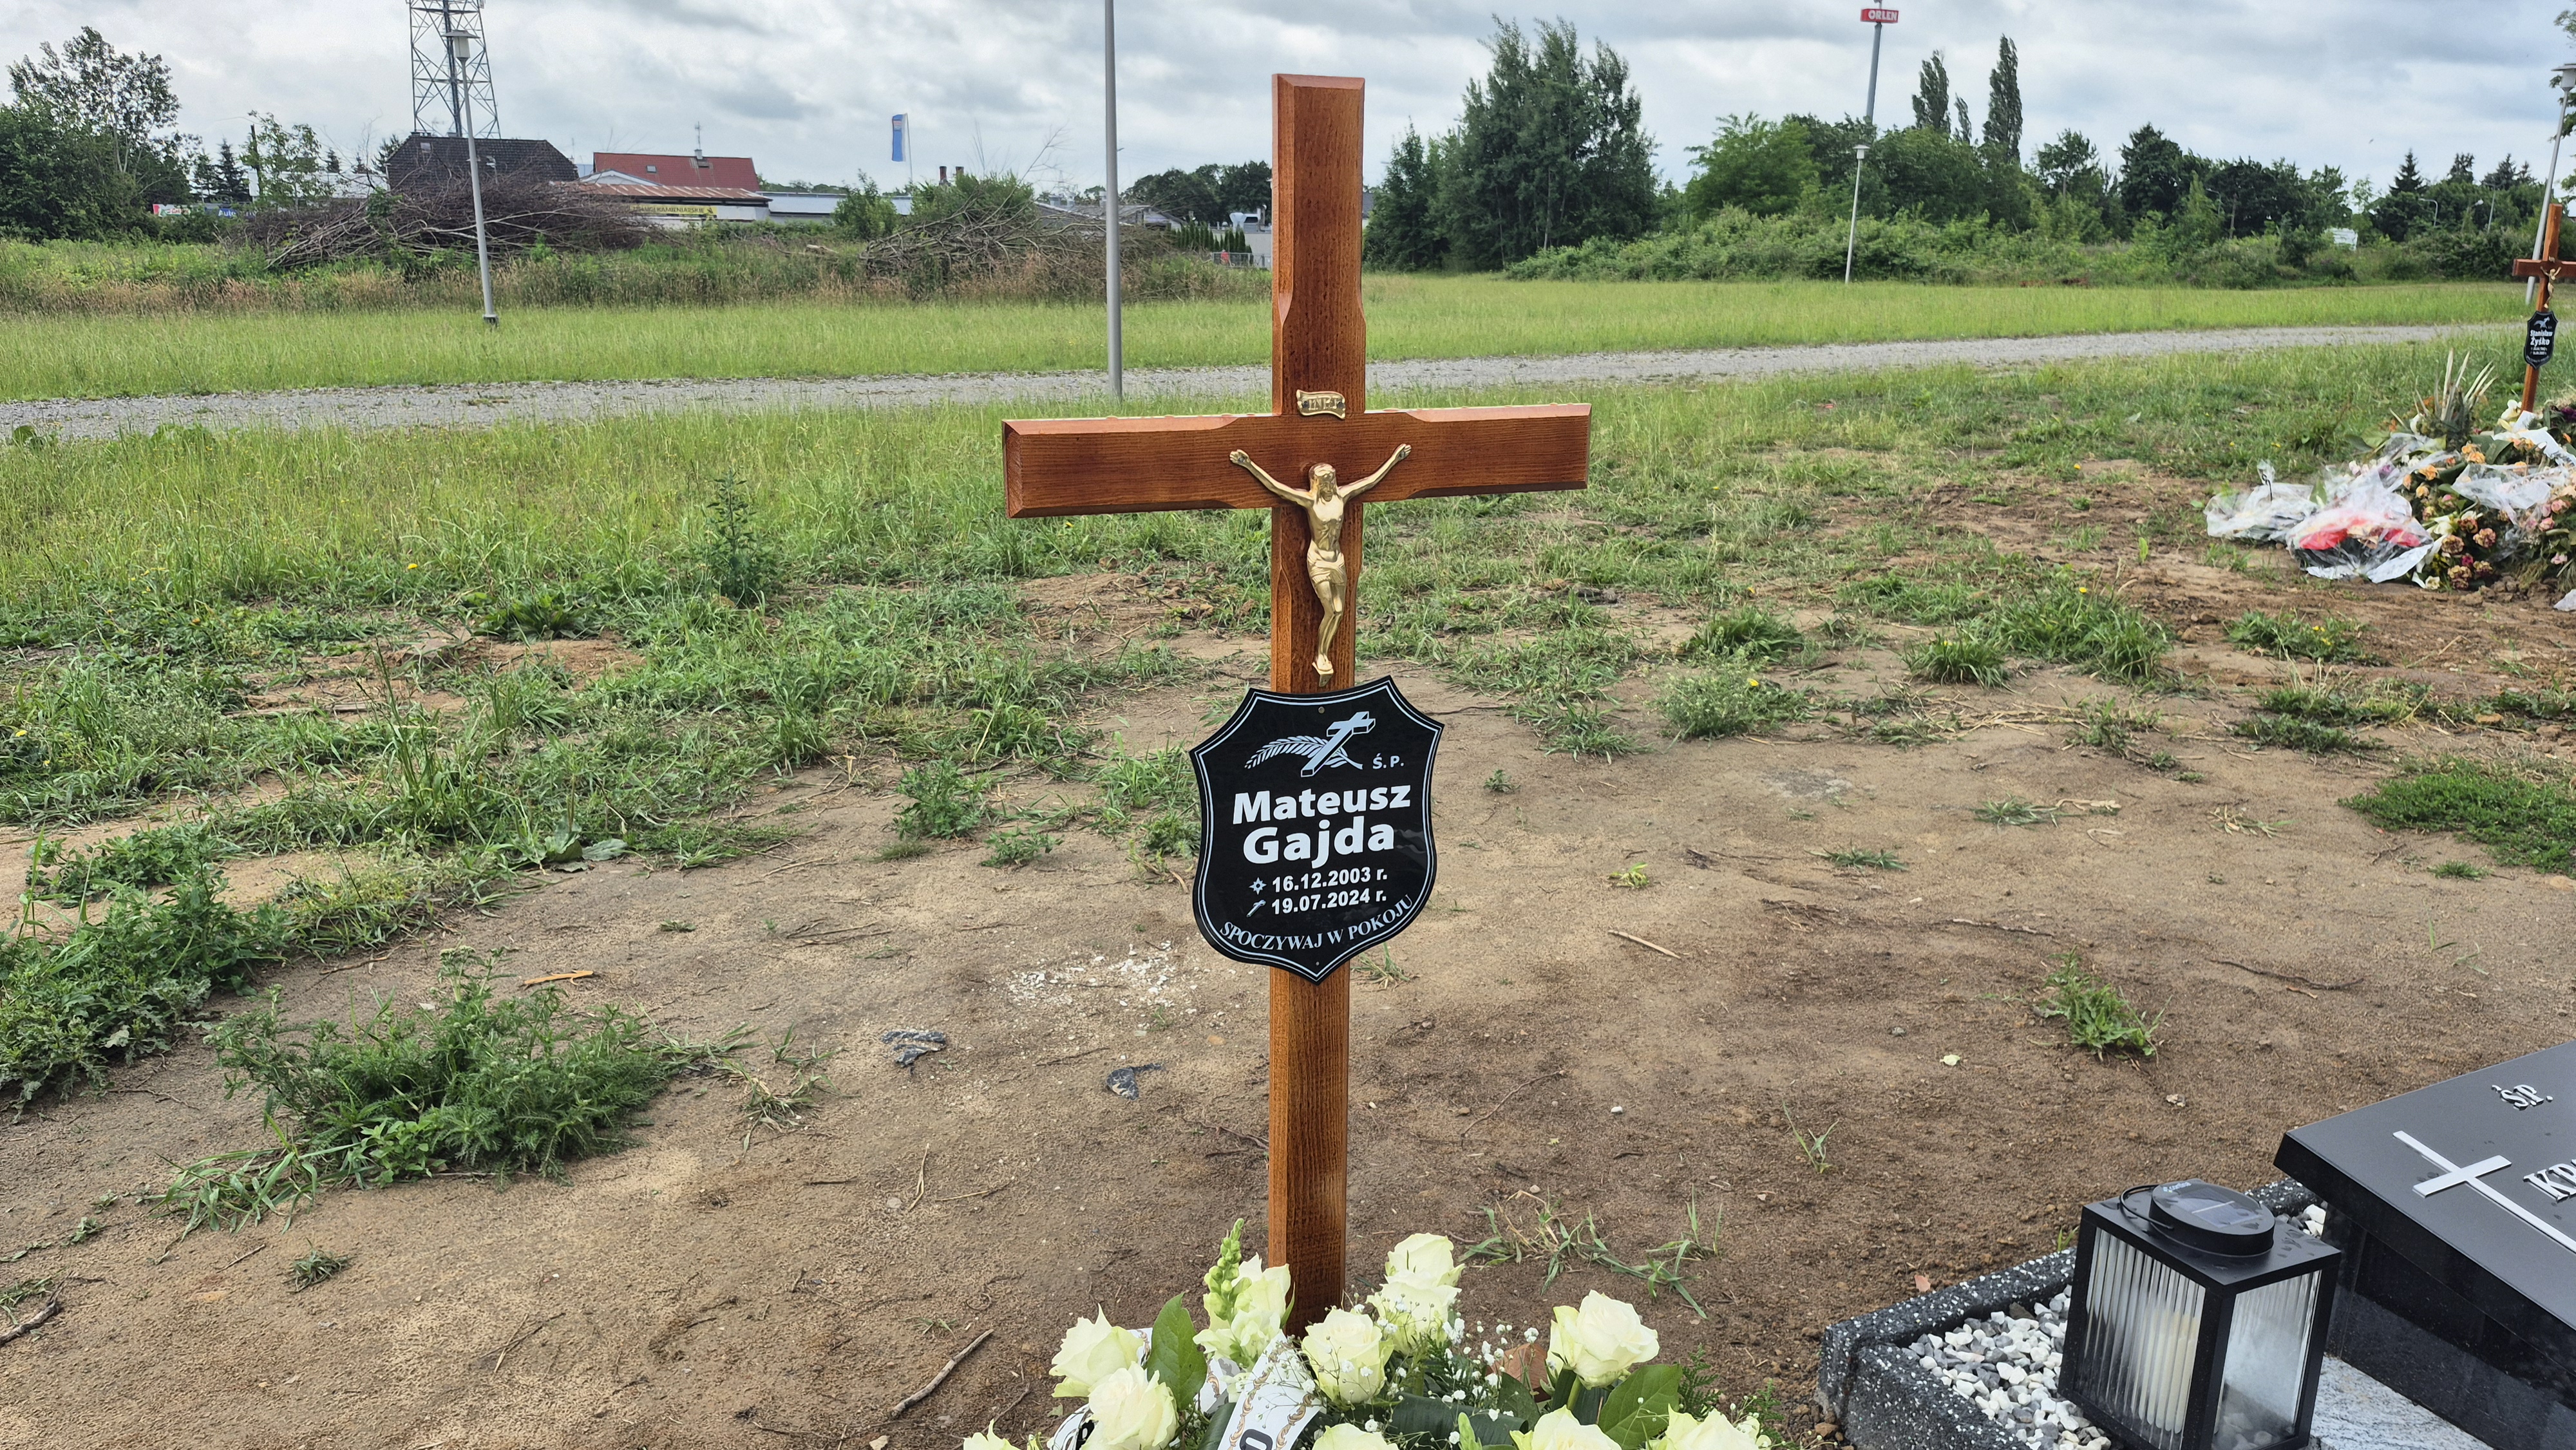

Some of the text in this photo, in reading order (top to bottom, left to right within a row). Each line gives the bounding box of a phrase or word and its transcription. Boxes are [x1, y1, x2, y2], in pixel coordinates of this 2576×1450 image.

[1868, 10, 1897, 21] ORLEN
[1233, 785, 1411, 824] Mateusz
[1243, 816, 1394, 868] Gajda
[1273, 867, 1388, 892] 16.12.2003 r.
[1272, 888, 1387, 915] 19.07.2024 r.
[1220, 894, 1413, 950] SPOCZYWAJ W POKOJU
